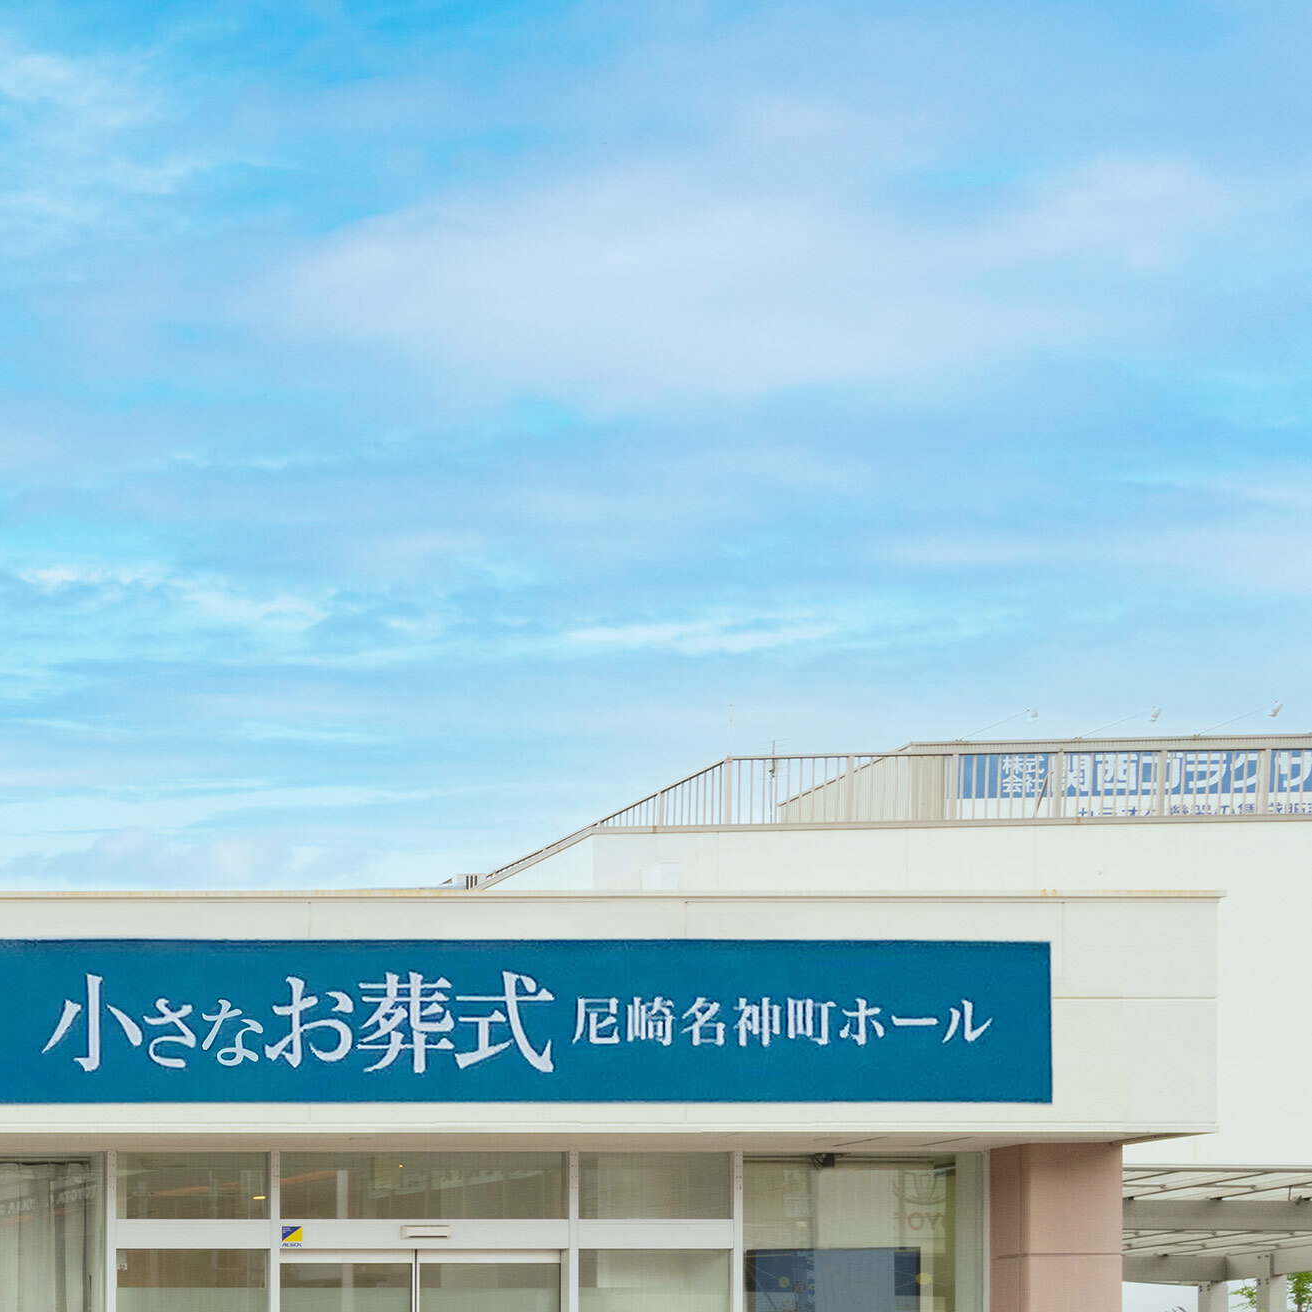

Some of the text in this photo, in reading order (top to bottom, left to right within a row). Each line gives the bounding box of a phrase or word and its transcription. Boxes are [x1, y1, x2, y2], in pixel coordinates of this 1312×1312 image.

[42, 972, 556, 1073] 小さなお葬式
[572, 996, 995, 1047] 尼崎名神町ホール
